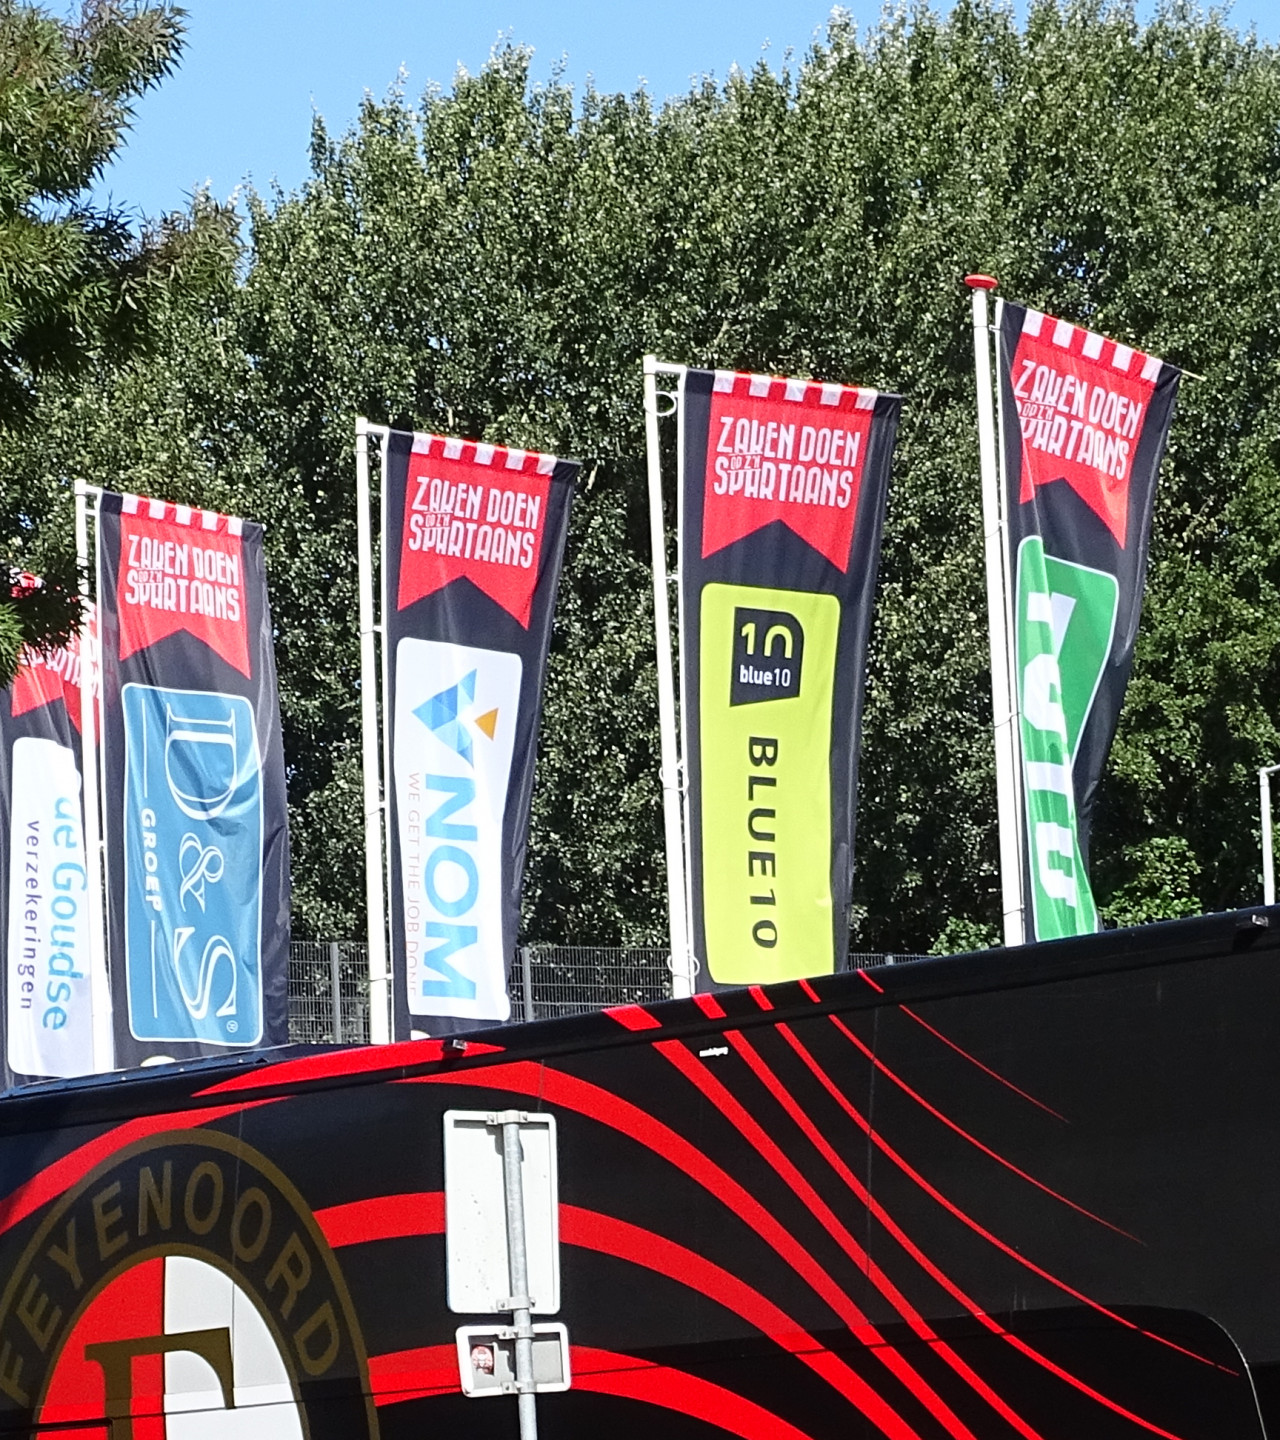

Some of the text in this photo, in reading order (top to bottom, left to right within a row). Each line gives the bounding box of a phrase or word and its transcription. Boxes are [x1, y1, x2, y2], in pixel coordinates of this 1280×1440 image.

[1088, 386, 1143, 439] DOEN
[798, 426, 861, 467] DOEN
[1016, 400, 1130, 480] PARTAANS
[486, 488, 541, 530] DOEN
[713, 456, 854, 509] SPARTAANS
[192, 547, 239, 587] DOEN
[408, 513, 535, 569] SPARTAANS
[125, 569, 240, 622] SPARTAANS
[739, 664, 791, 687] blue10
[408, 810, 420, 846] GET
[747, 736, 778, 949] BLUE10
[141, 809, 162, 912] GROEP
[408, 853, 420, 889] THE
[18, 820, 43, 1009] verzekeringen
[406, 896, 420, 933] JOB
[43, 862, 88, 1031] Goudse
